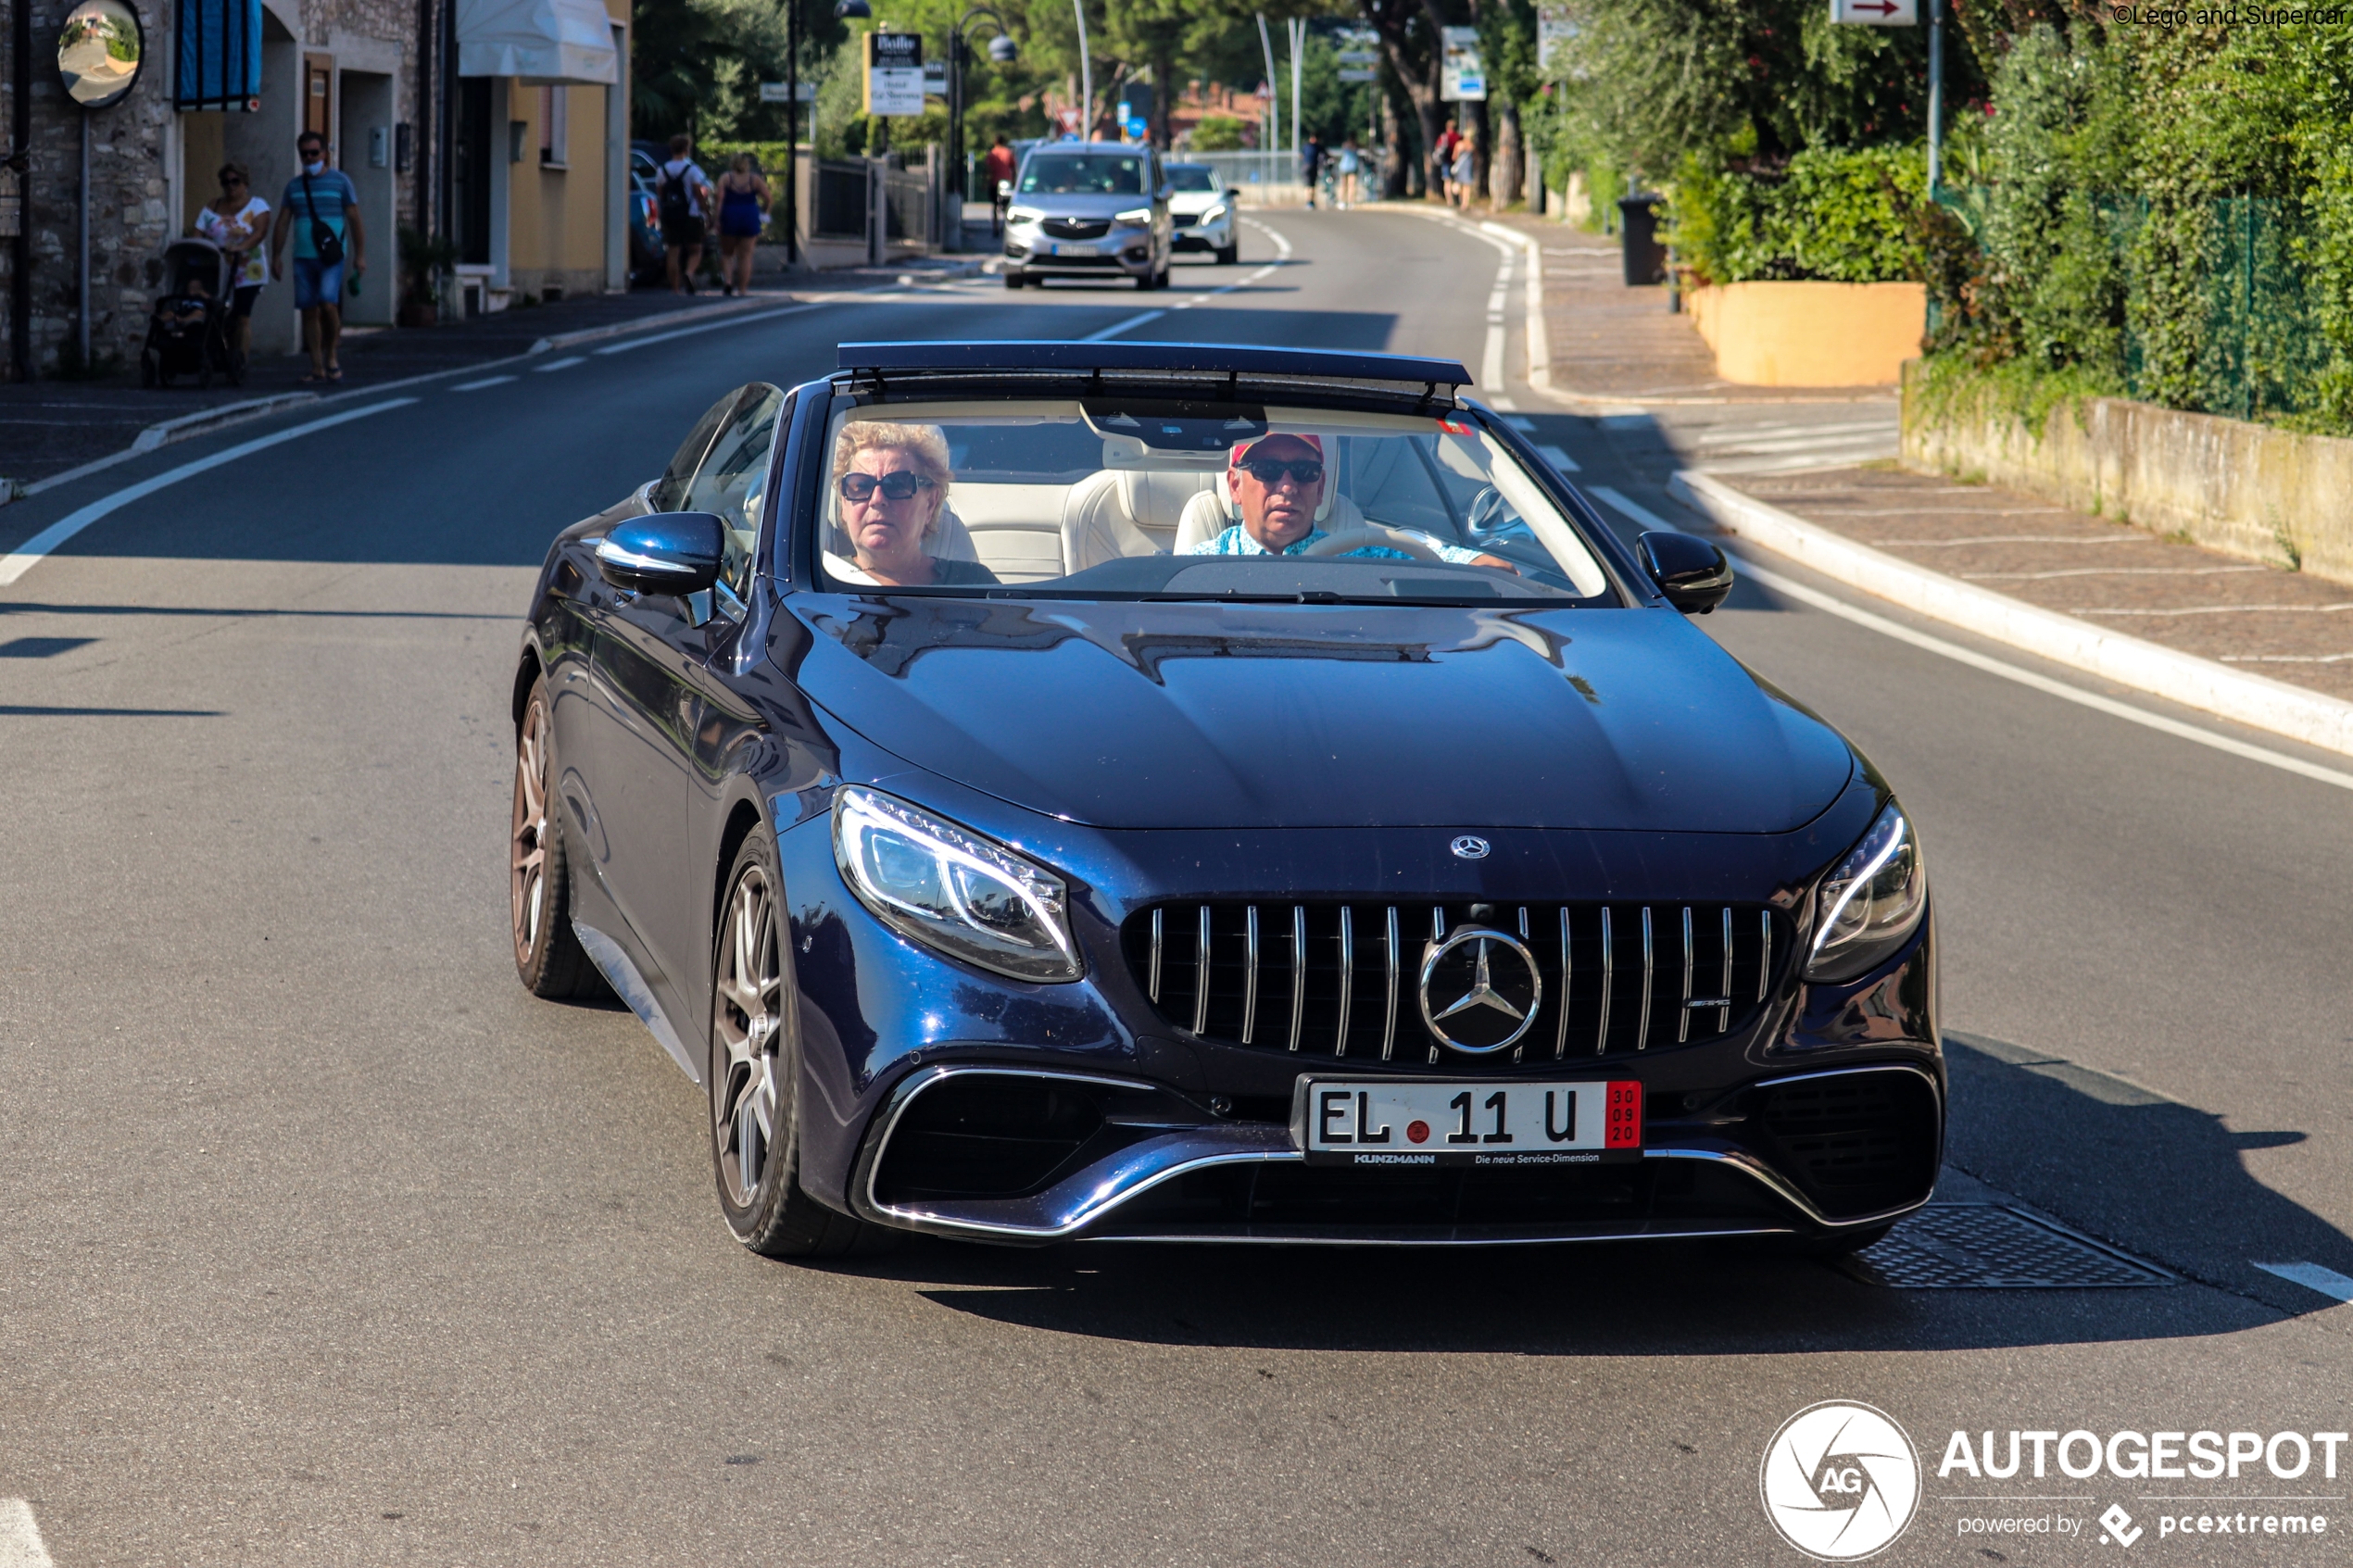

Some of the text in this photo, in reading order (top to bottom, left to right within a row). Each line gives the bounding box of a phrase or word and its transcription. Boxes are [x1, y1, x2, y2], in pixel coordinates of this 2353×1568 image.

[1614, 1090, 1633, 1104] 30
[1319, 1091, 1390, 1144] EL
[1447, 1091, 1514, 1144] 11
[1545, 1090, 1577, 1143] U
[1613, 1108, 1632, 1122] 09
[1613, 1126, 1632, 1141] 20
[1353, 1154, 1435, 1164] KUNZMANN
[1475, 1153, 1600, 1164] Die neue Service-Dimension
